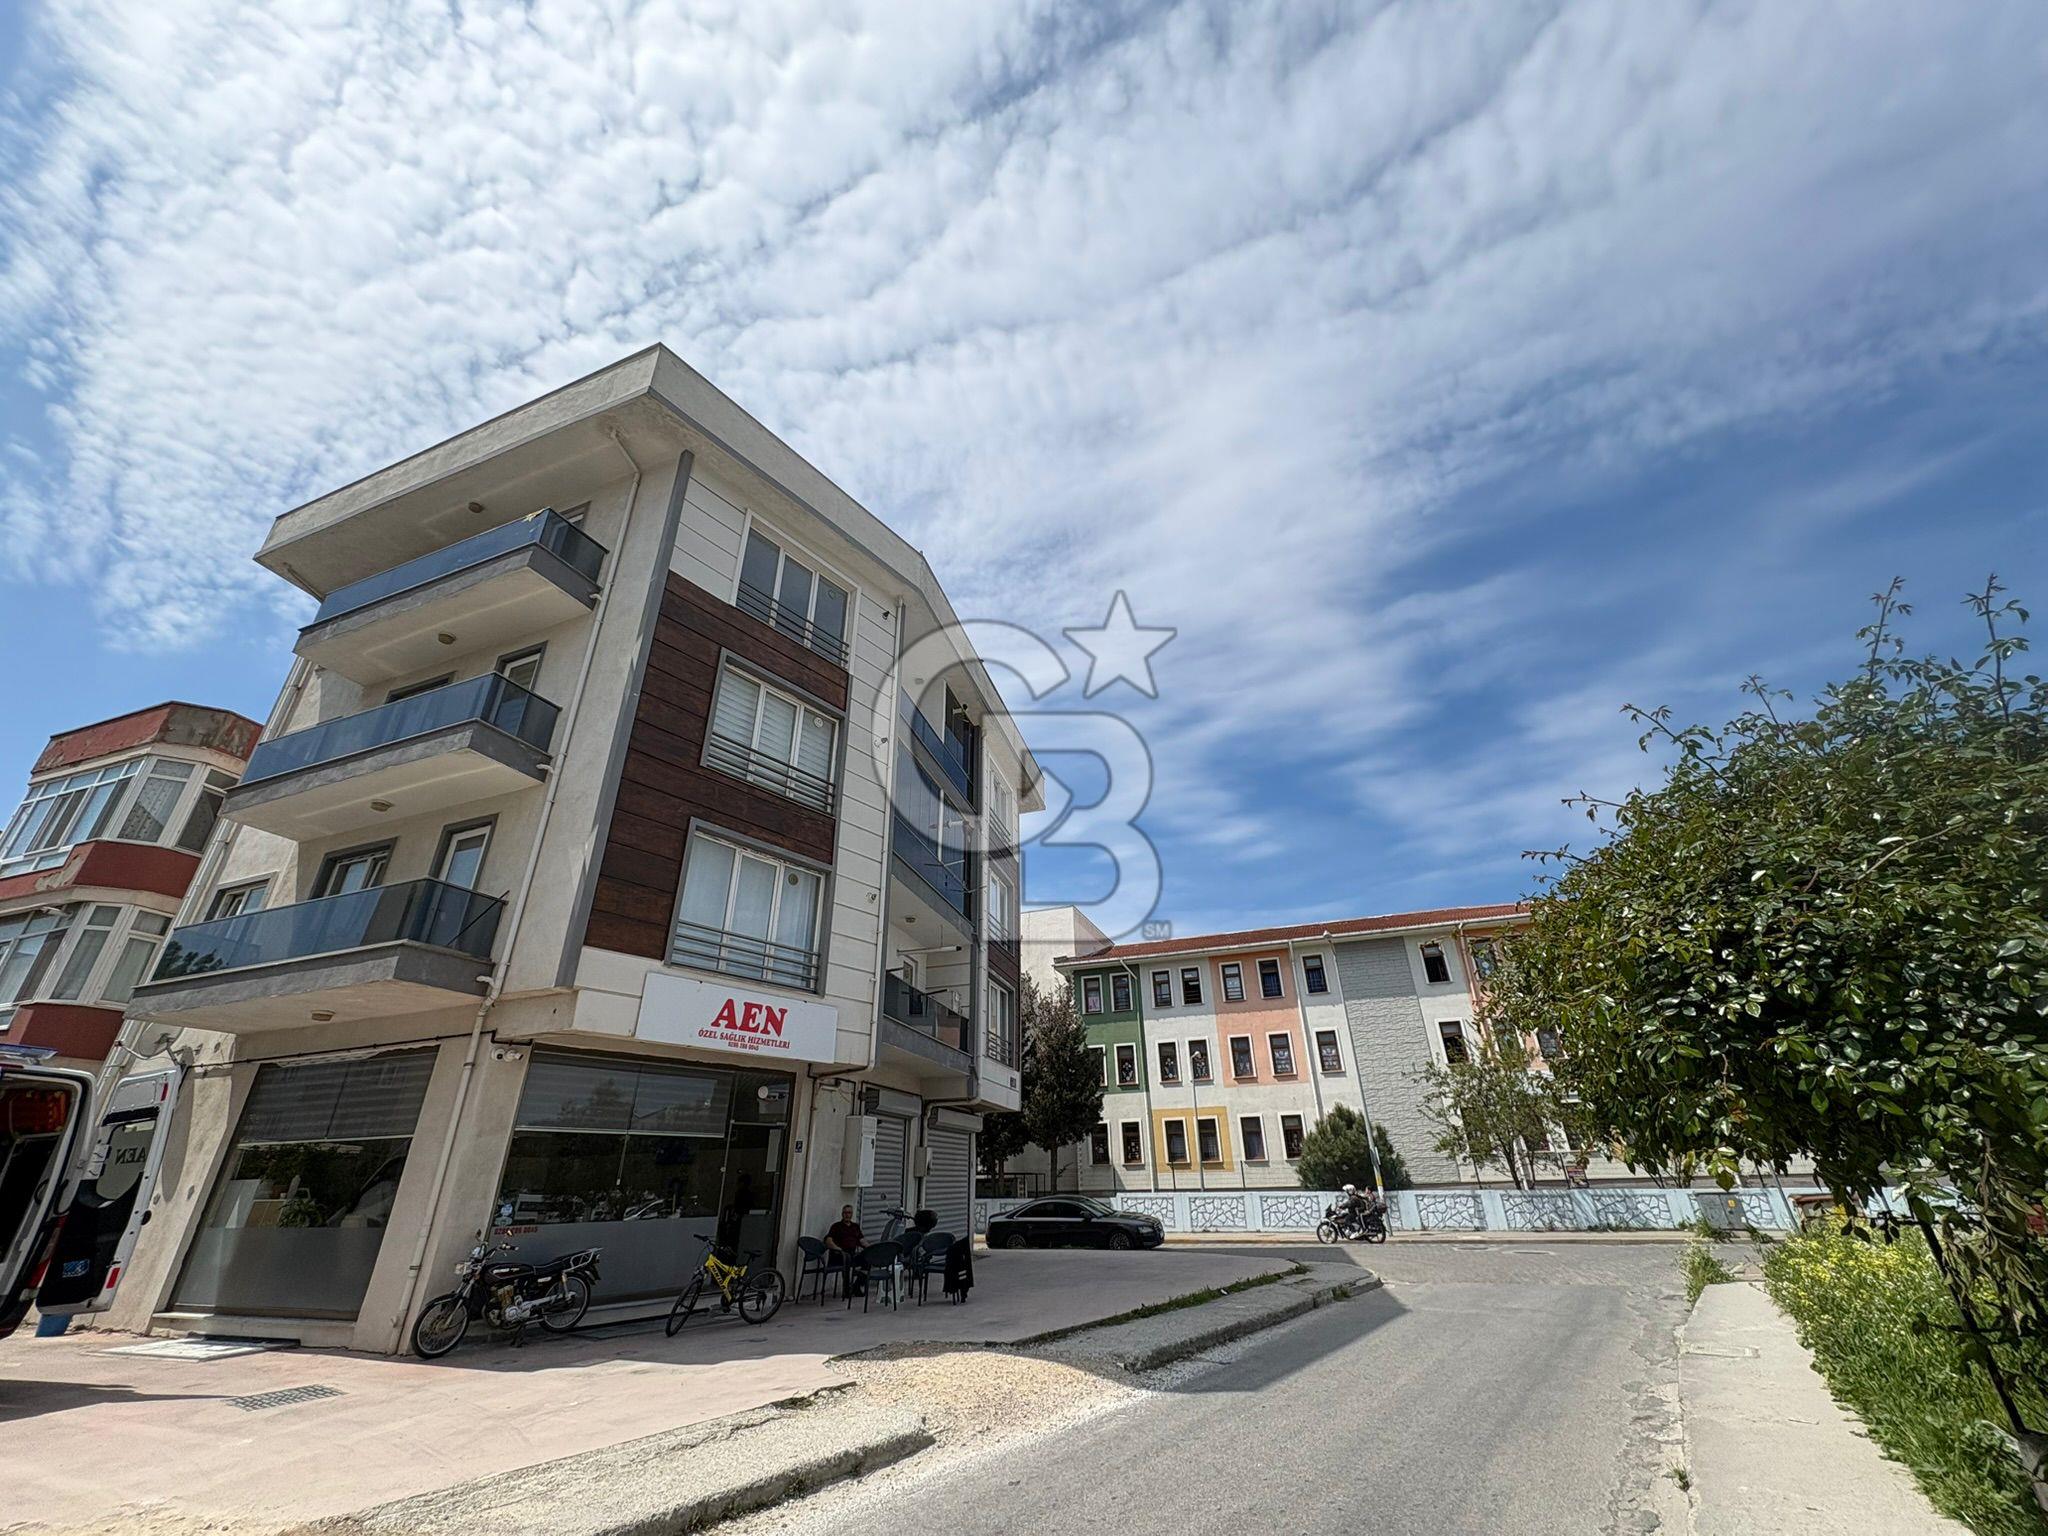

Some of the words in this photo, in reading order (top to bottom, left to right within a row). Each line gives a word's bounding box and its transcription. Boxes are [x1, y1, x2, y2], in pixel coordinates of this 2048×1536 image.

[711, 998, 788, 1037] AEN
[698, 1027, 718, 1039] ÖZEL
[719, 1031, 747, 1043] SAĞLIK
[748, 1034, 791, 1049] HİZMETLERİ
